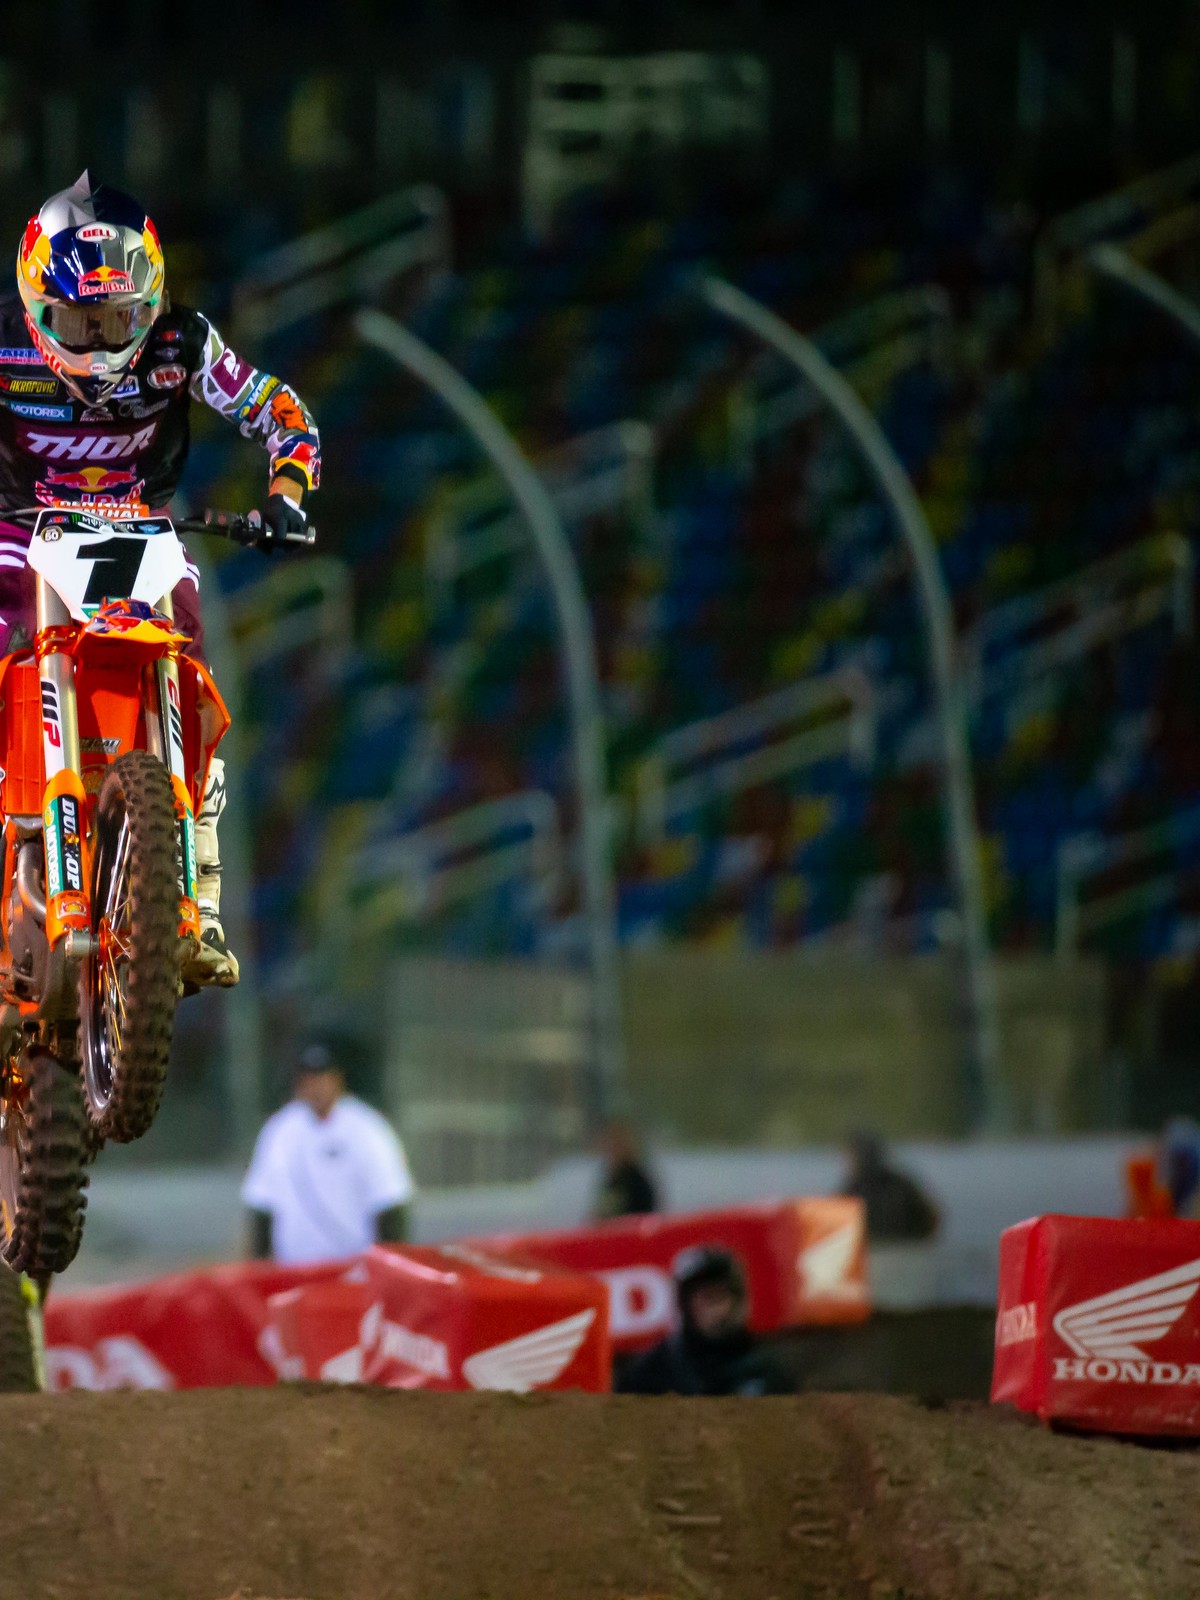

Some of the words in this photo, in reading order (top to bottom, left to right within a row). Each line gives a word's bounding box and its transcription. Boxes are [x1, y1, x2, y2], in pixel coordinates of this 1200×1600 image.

[82, 228, 111, 238] BELL
[79, 281, 107, 295] Red
[108, 281, 135, 292] Bull
[11, 402, 65, 418] MOTOREX
[26, 422, 157, 460] THOR
[76, 537, 148, 604] 1
[62, 798, 81, 890] DUOP
